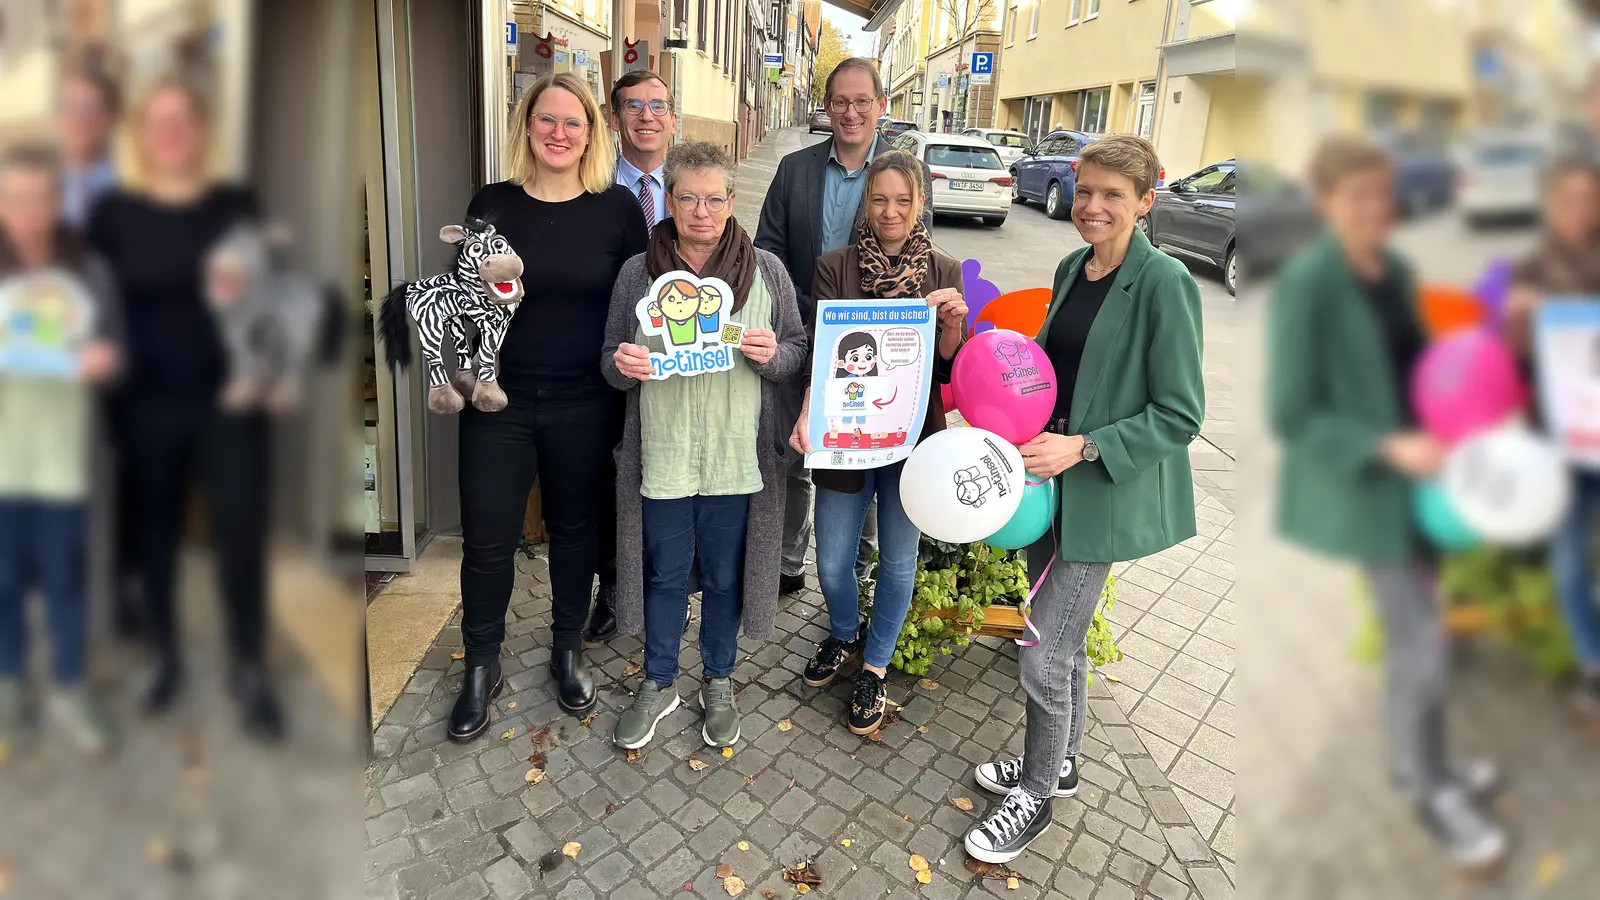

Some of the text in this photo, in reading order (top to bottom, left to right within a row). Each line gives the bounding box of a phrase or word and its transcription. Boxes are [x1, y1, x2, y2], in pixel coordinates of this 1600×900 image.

[975, 54, 988, 72] P
[825, 309, 929, 321] Wo wir sind, bist du sicher!
[650, 345, 731, 377] notinsel
[1001, 364, 1039, 382] notinsel
[842, 400, 865, 408] notinsel
[979, 454, 1008, 498] notinsel
